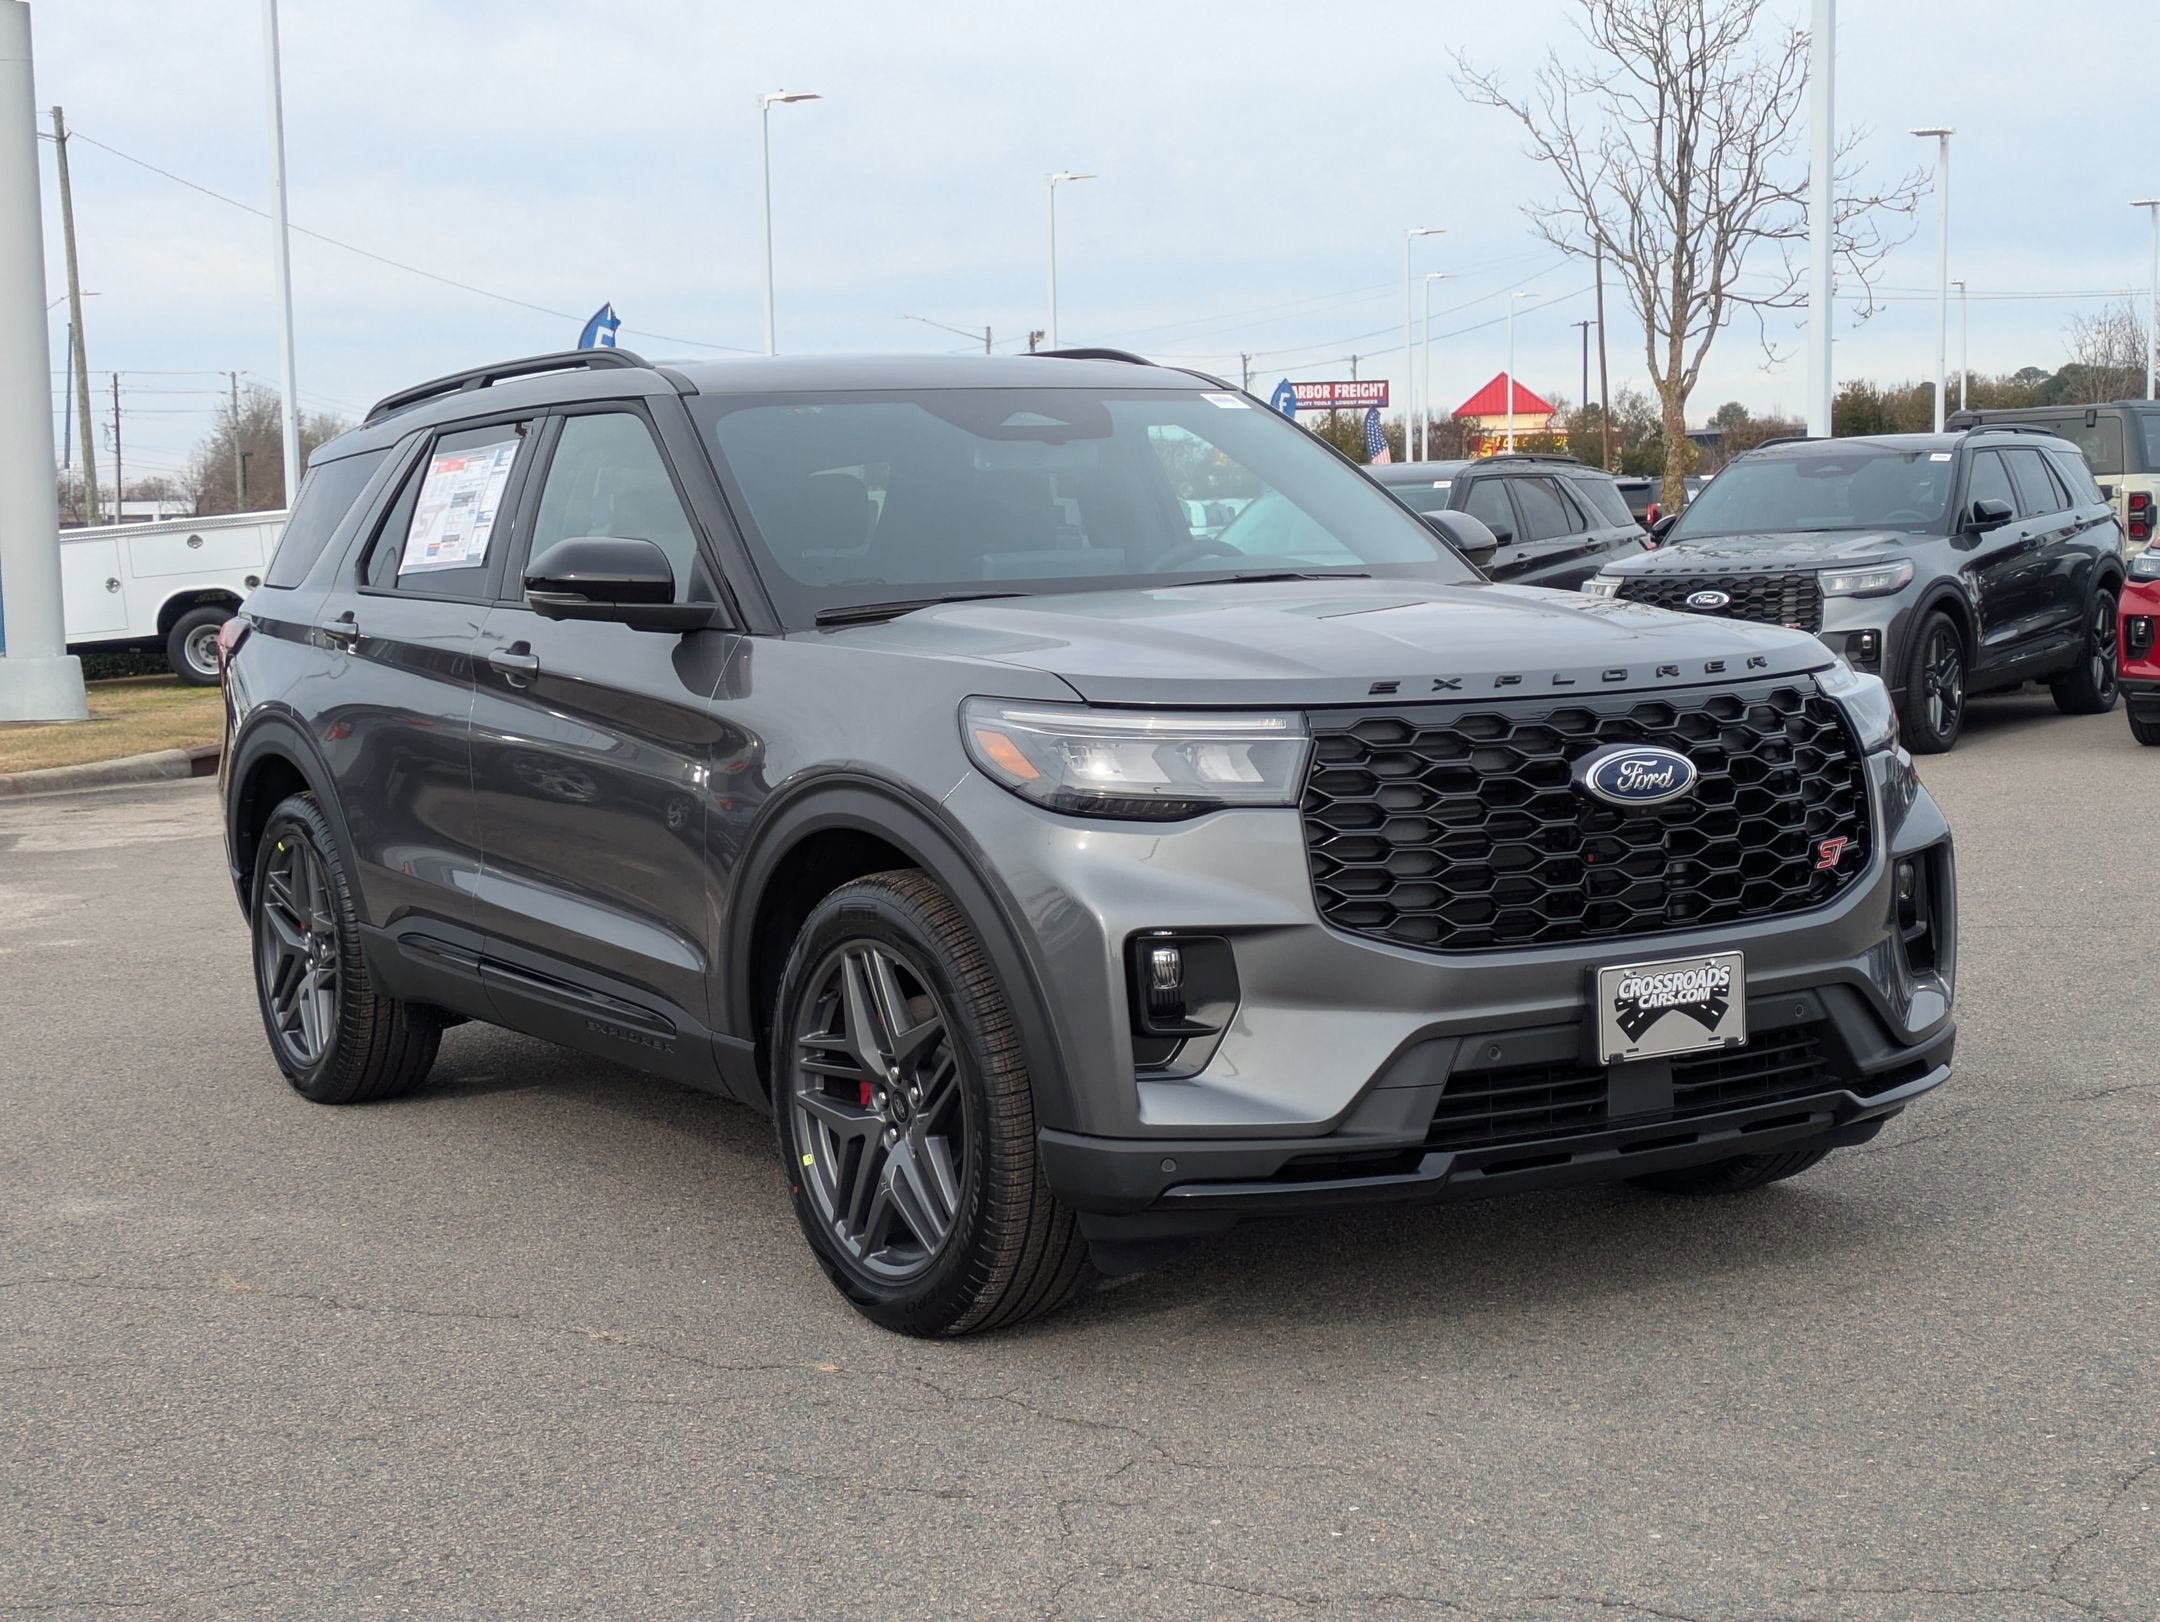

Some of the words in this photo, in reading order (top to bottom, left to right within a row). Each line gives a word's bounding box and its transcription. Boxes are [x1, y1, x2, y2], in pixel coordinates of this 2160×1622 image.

[1292, 384, 1331, 399] ARBOR
[1334, 383, 1386, 398] FREIGHT
[1695, 594, 1719, 605] Ford
[1368, 655, 1769, 695] EXPLORER
[1617, 760, 1675, 792] Ford
[1816, 835, 1848, 869] ST
[1618, 966, 1731, 999] CROSSROADS
[1638, 987, 1711, 1009] CARS.COM
